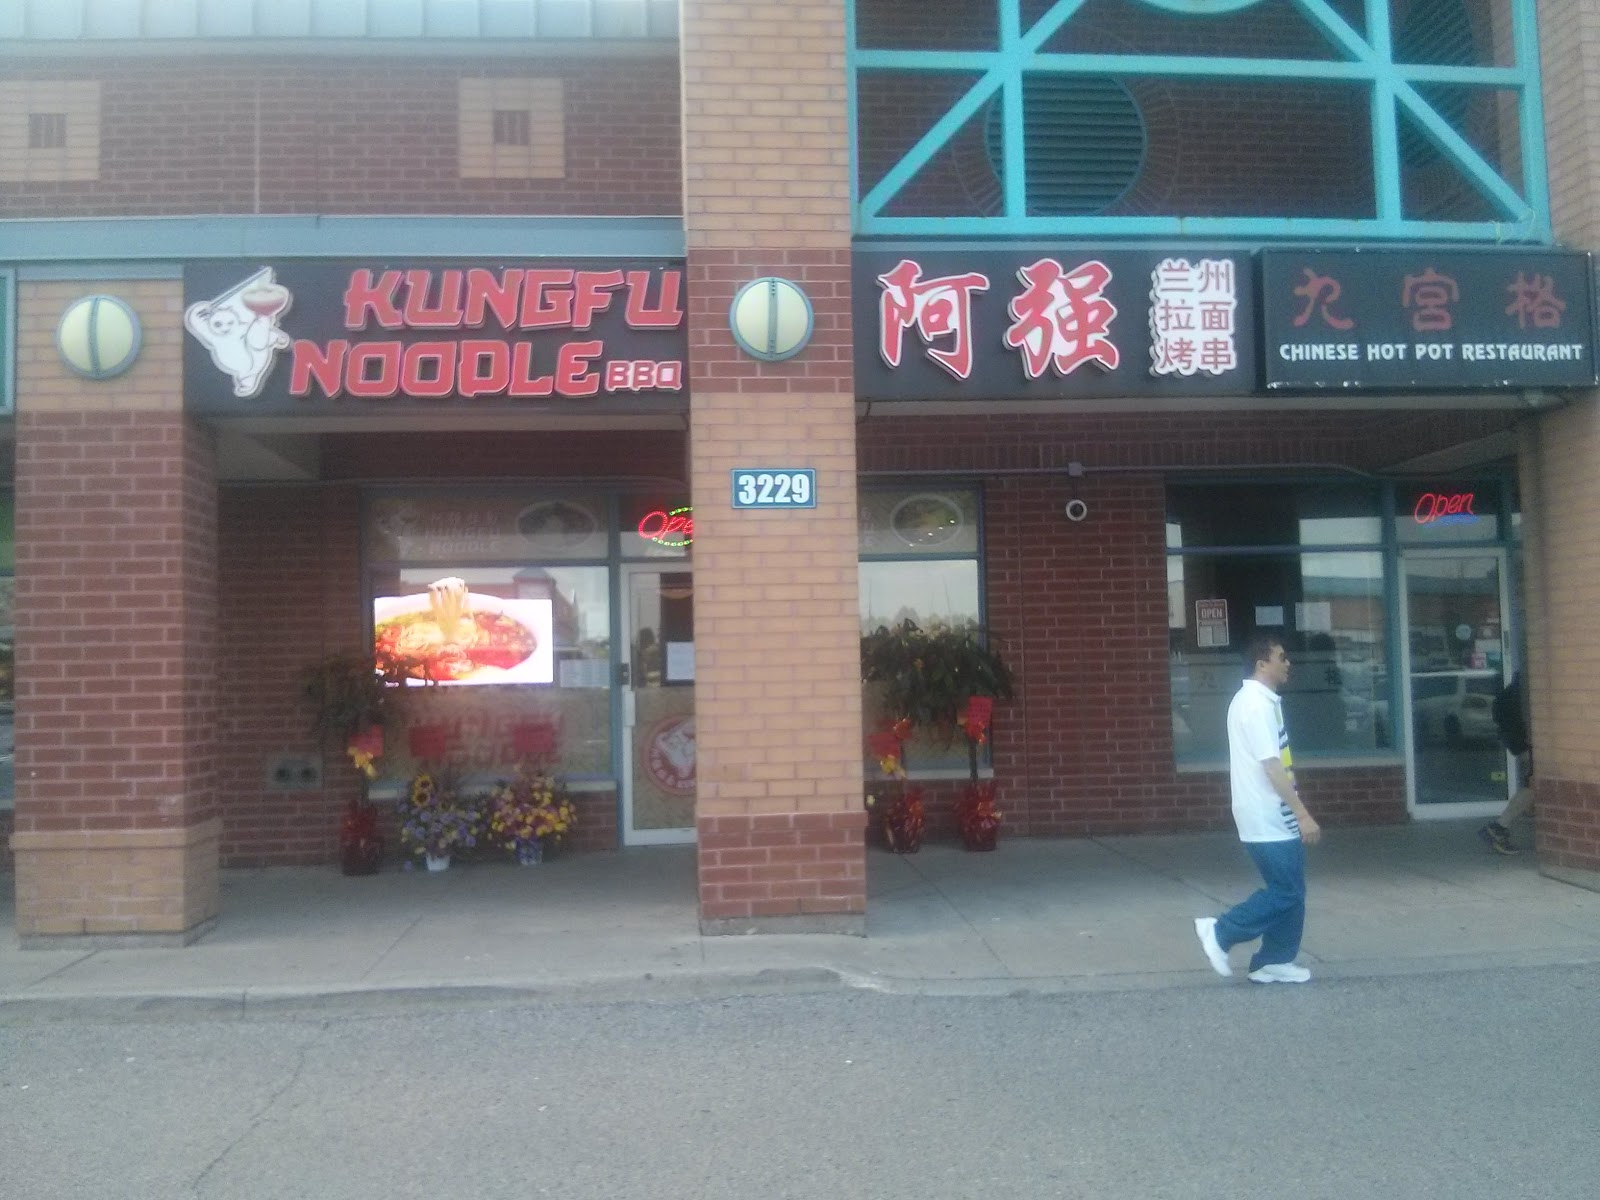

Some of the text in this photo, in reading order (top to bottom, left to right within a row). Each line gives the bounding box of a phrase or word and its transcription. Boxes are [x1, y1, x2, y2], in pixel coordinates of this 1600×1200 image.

[1157, 259, 1234, 295] 兰州
[343, 268, 683, 330] KUNGFU
[1157, 299, 1234, 333] 拉面
[875, 258, 1120, 380] 阿强
[289, 338, 682, 398] NOODLE BBQ
[1157, 336, 1234, 372] 烤串
[1278, 343, 1584, 362] CHINESE HOT POT RESTAURANT
[738, 473, 810, 505] 3229
[1414, 492, 1475, 524] Open
[1201, 607, 1223, 619] OPEN
